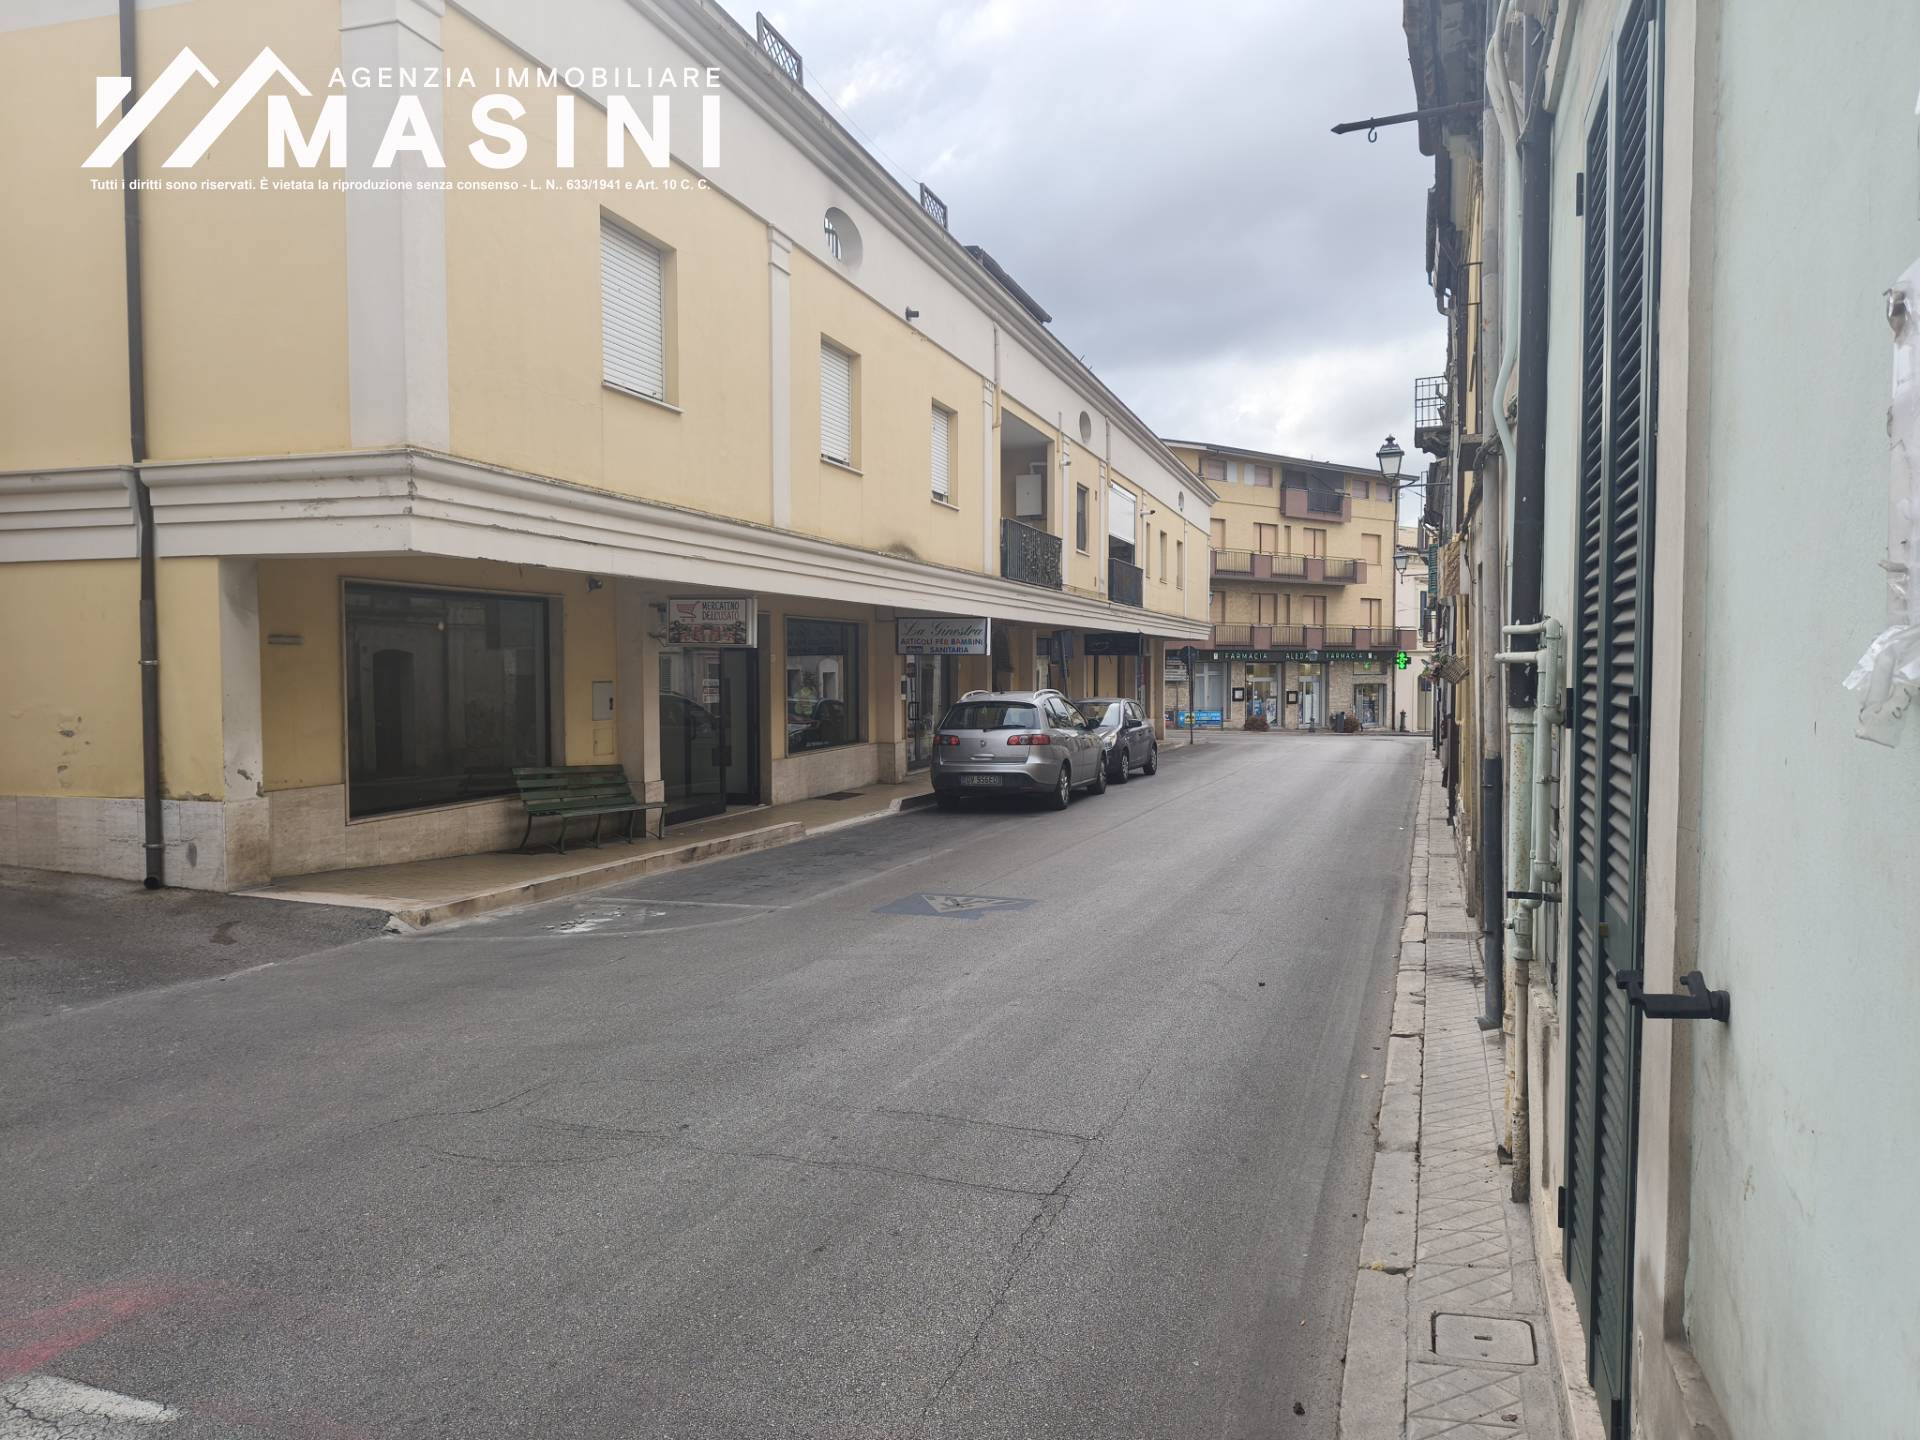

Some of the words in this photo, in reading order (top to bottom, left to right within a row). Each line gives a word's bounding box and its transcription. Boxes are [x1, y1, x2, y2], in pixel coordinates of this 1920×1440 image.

[703, 601, 739, 610] MERCATINO
[703, 611, 738, 620] DELL'USATO
[904, 621, 925, 635] La
[930, 621, 983, 636] Ginestra
[901, 638, 933, 646] ARTICOLI
[935, 638, 949, 646] PER
[951, 638, 984, 646] BAMBINI
[1224, 652, 1268, 660] FARMACIA
[1326, 652, 1363, 660] FARMACIA
